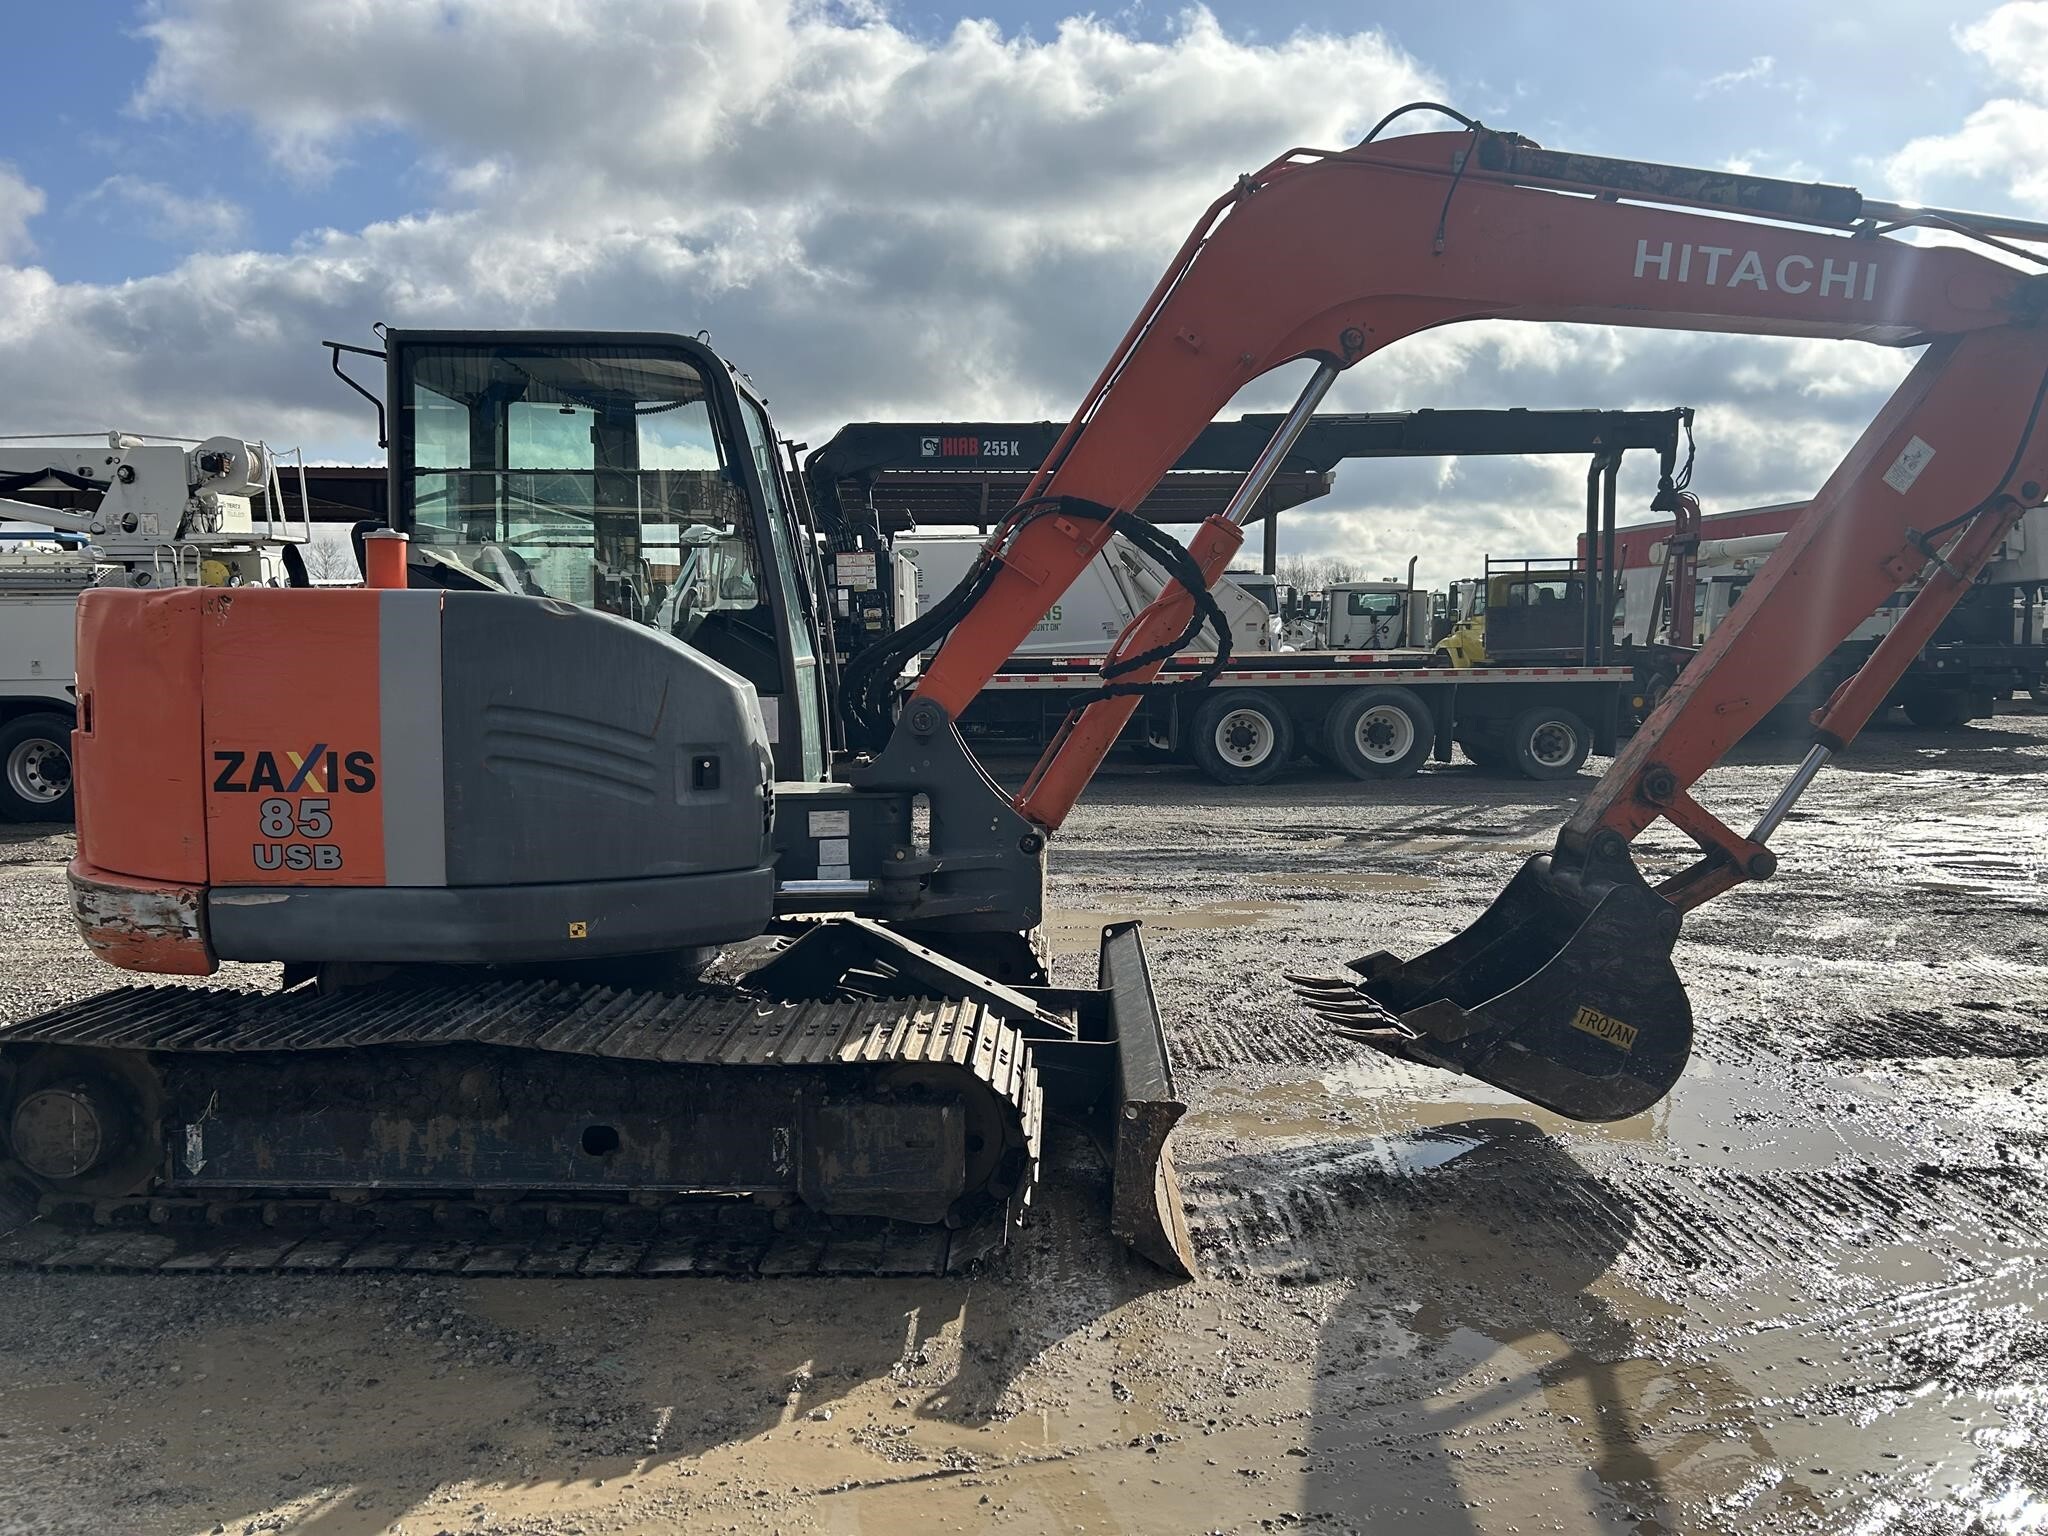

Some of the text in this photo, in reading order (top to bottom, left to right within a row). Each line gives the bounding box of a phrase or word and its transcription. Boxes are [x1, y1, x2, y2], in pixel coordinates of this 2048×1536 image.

[1633, 239, 1877, 301] HITACHI
[943, 437, 1019, 456] HIAB 255 K
[213, 743, 376, 794] ZAXIS
[259, 797, 332, 839] 85
[253, 844, 342, 871] USB
[1578, 1008, 1636, 1045] TROJAN
